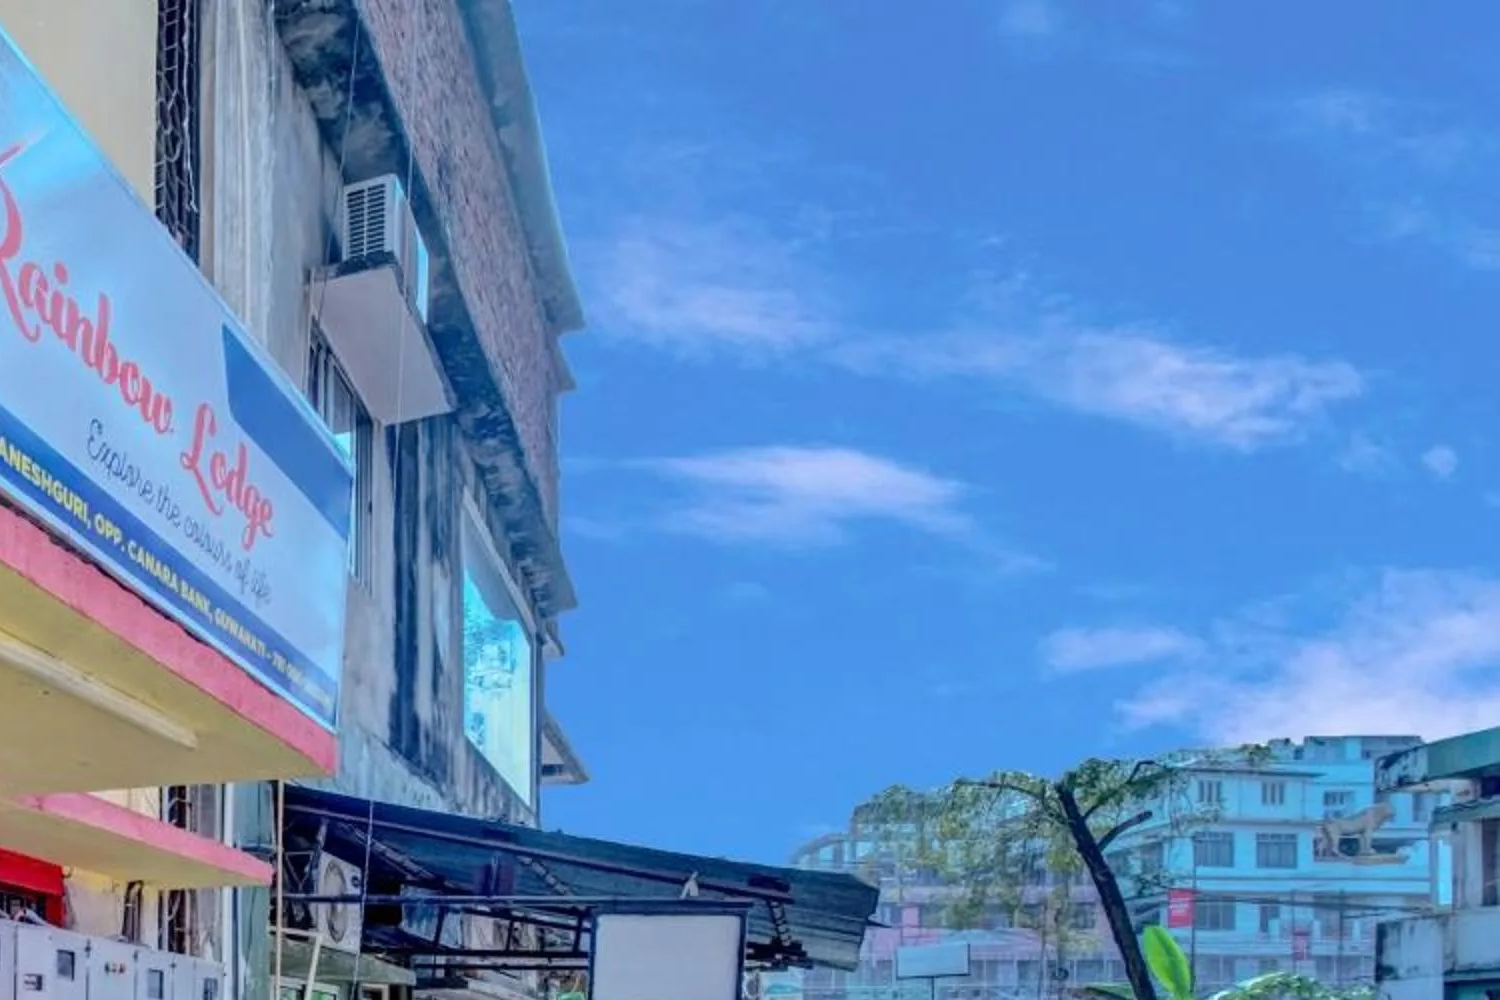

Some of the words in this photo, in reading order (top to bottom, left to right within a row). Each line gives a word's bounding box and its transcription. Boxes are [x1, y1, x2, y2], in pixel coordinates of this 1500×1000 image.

[87, 418, 155, 503] Explore
[157, 484, 180, 527] the
[181, 403, 273, 551] Lodge
[94, 512, 125, 551] OPP.
[128, 540, 180, 593] CANARA
